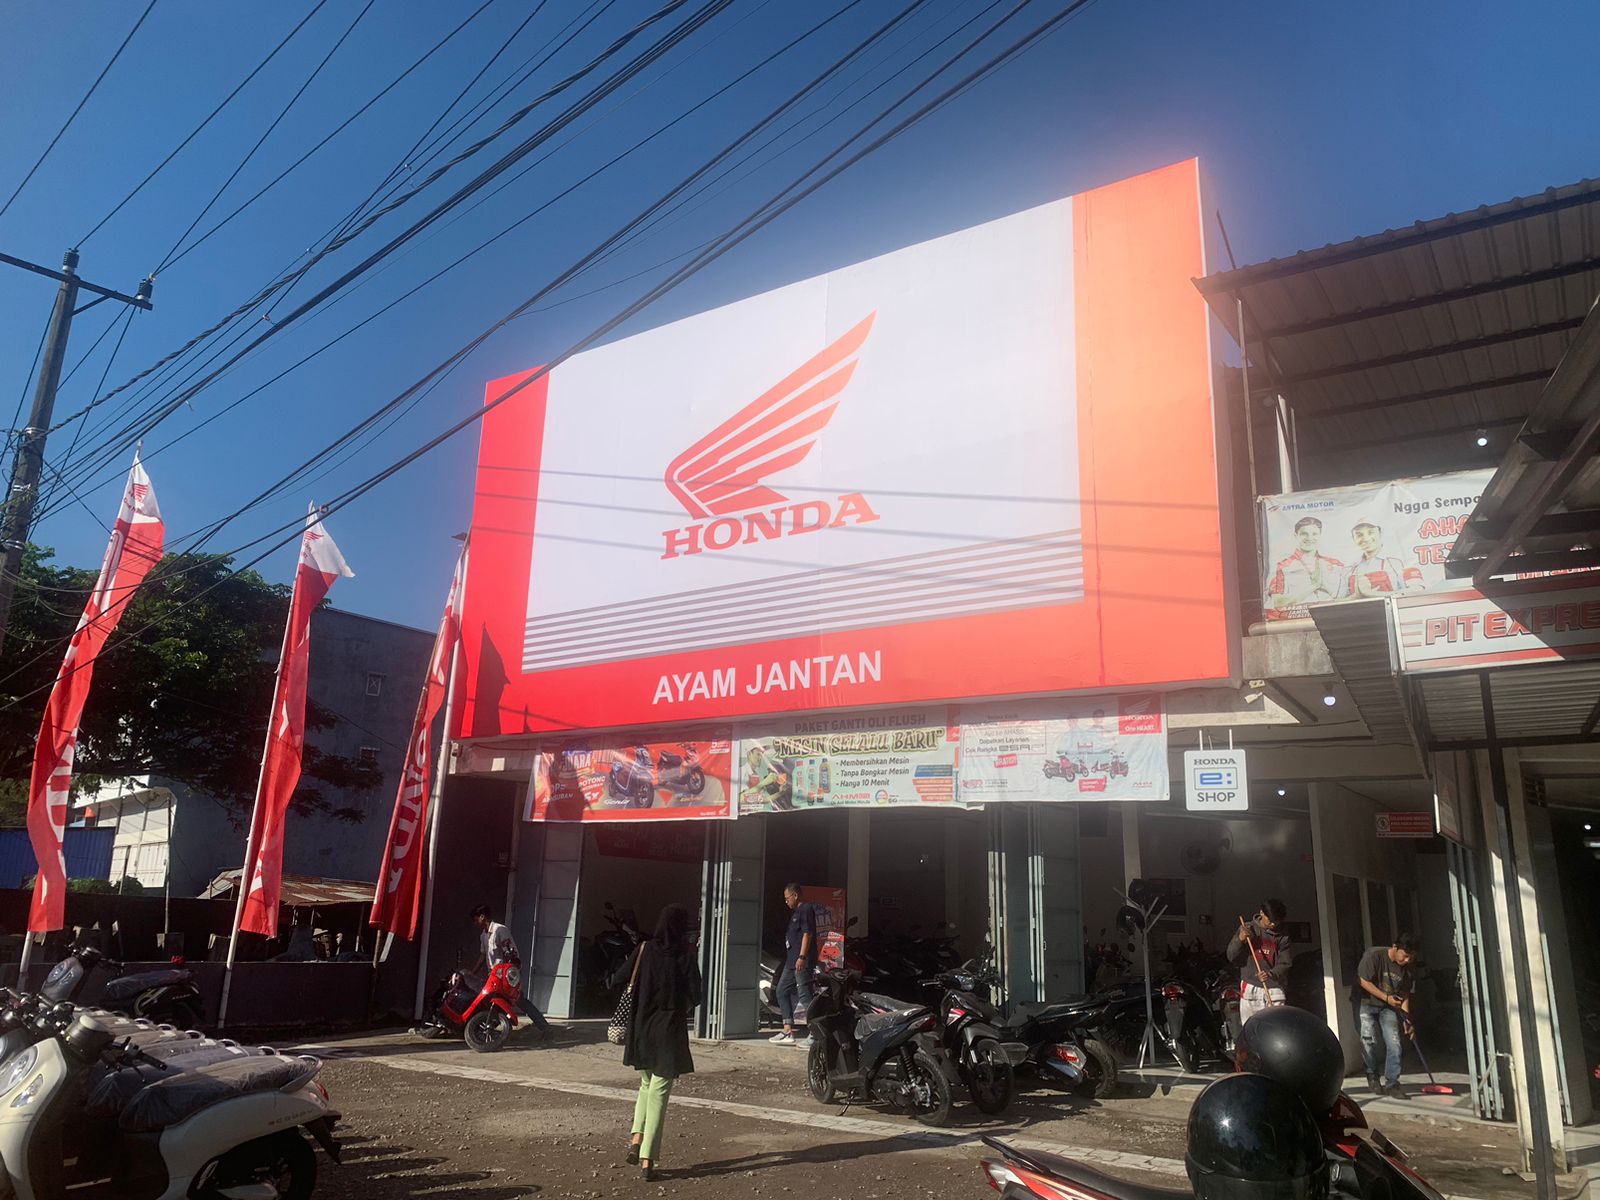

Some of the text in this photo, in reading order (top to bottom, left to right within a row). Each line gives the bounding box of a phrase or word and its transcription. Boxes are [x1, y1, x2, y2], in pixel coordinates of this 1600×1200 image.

[1282, 503, 1306, 512] ASTRA
[1307, 501, 1335, 509] MOTOR
[1394, 501, 1430, 514] Ngga
[661, 492, 880, 560] HONDA
[1426, 613, 1480, 645] PIT
[652, 650, 882, 705] AYAM JANTAN
[795, 714, 926, 734] PAKET GANTI OLI FLUSH
[831, 732, 888, 753] SELALU
[840, 756, 910, 767] Membersihkan Mesin
[841, 769, 860, 778] Tanpa
[860, 768, 888, 778] Bongkar
[888, 767, 910, 775] Mesin
[840, 778, 890, 789] Hanya 10 Menit
[1197, 791, 1236, 802] SHOP
